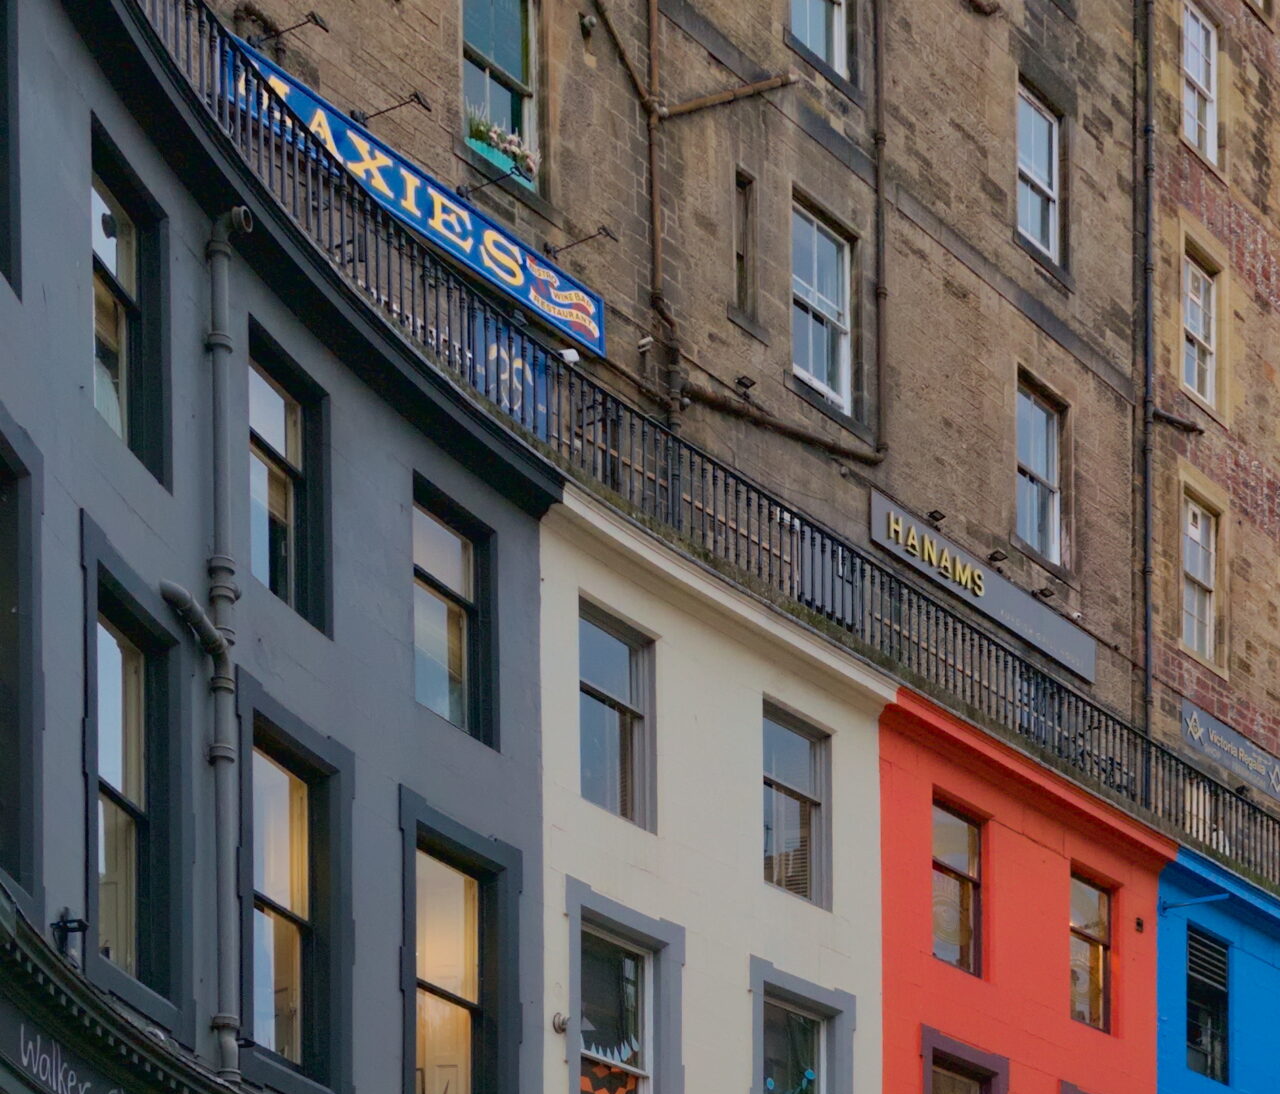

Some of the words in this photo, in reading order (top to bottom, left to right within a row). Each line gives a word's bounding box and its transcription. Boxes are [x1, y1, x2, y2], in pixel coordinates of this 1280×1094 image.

[238, 58, 525, 287] MAXIES
[888, 510, 985, 597] HANAMS
[1208, 728, 1238, 757] Victoria
